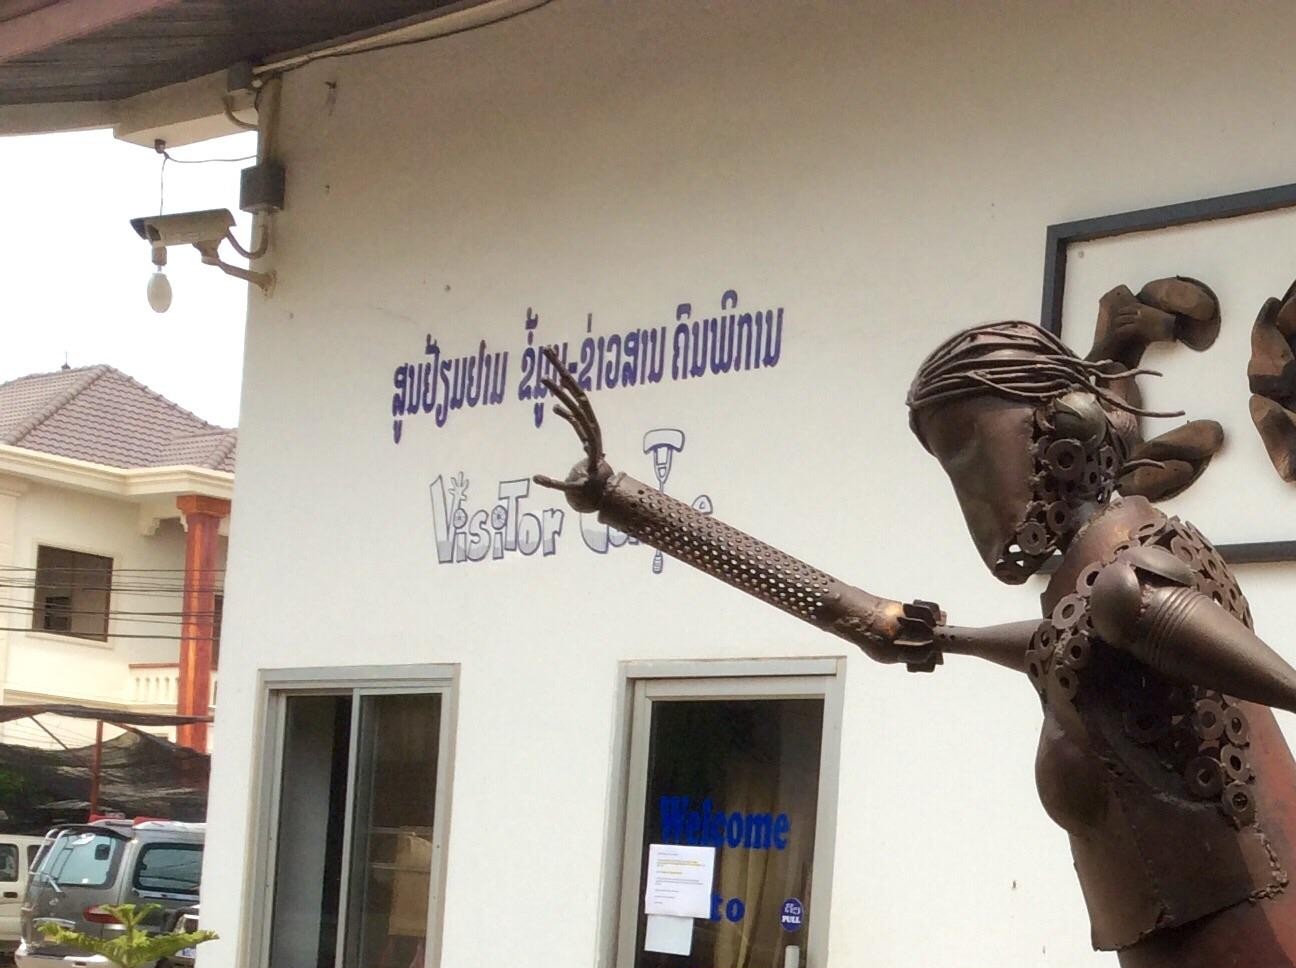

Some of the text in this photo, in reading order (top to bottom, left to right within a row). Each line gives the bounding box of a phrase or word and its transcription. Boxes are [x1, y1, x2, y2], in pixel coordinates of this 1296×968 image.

[659, 795, 791, 850] Welcome
[710, 892, 745, 923] to
[781, 915, 801, 924] PULL
